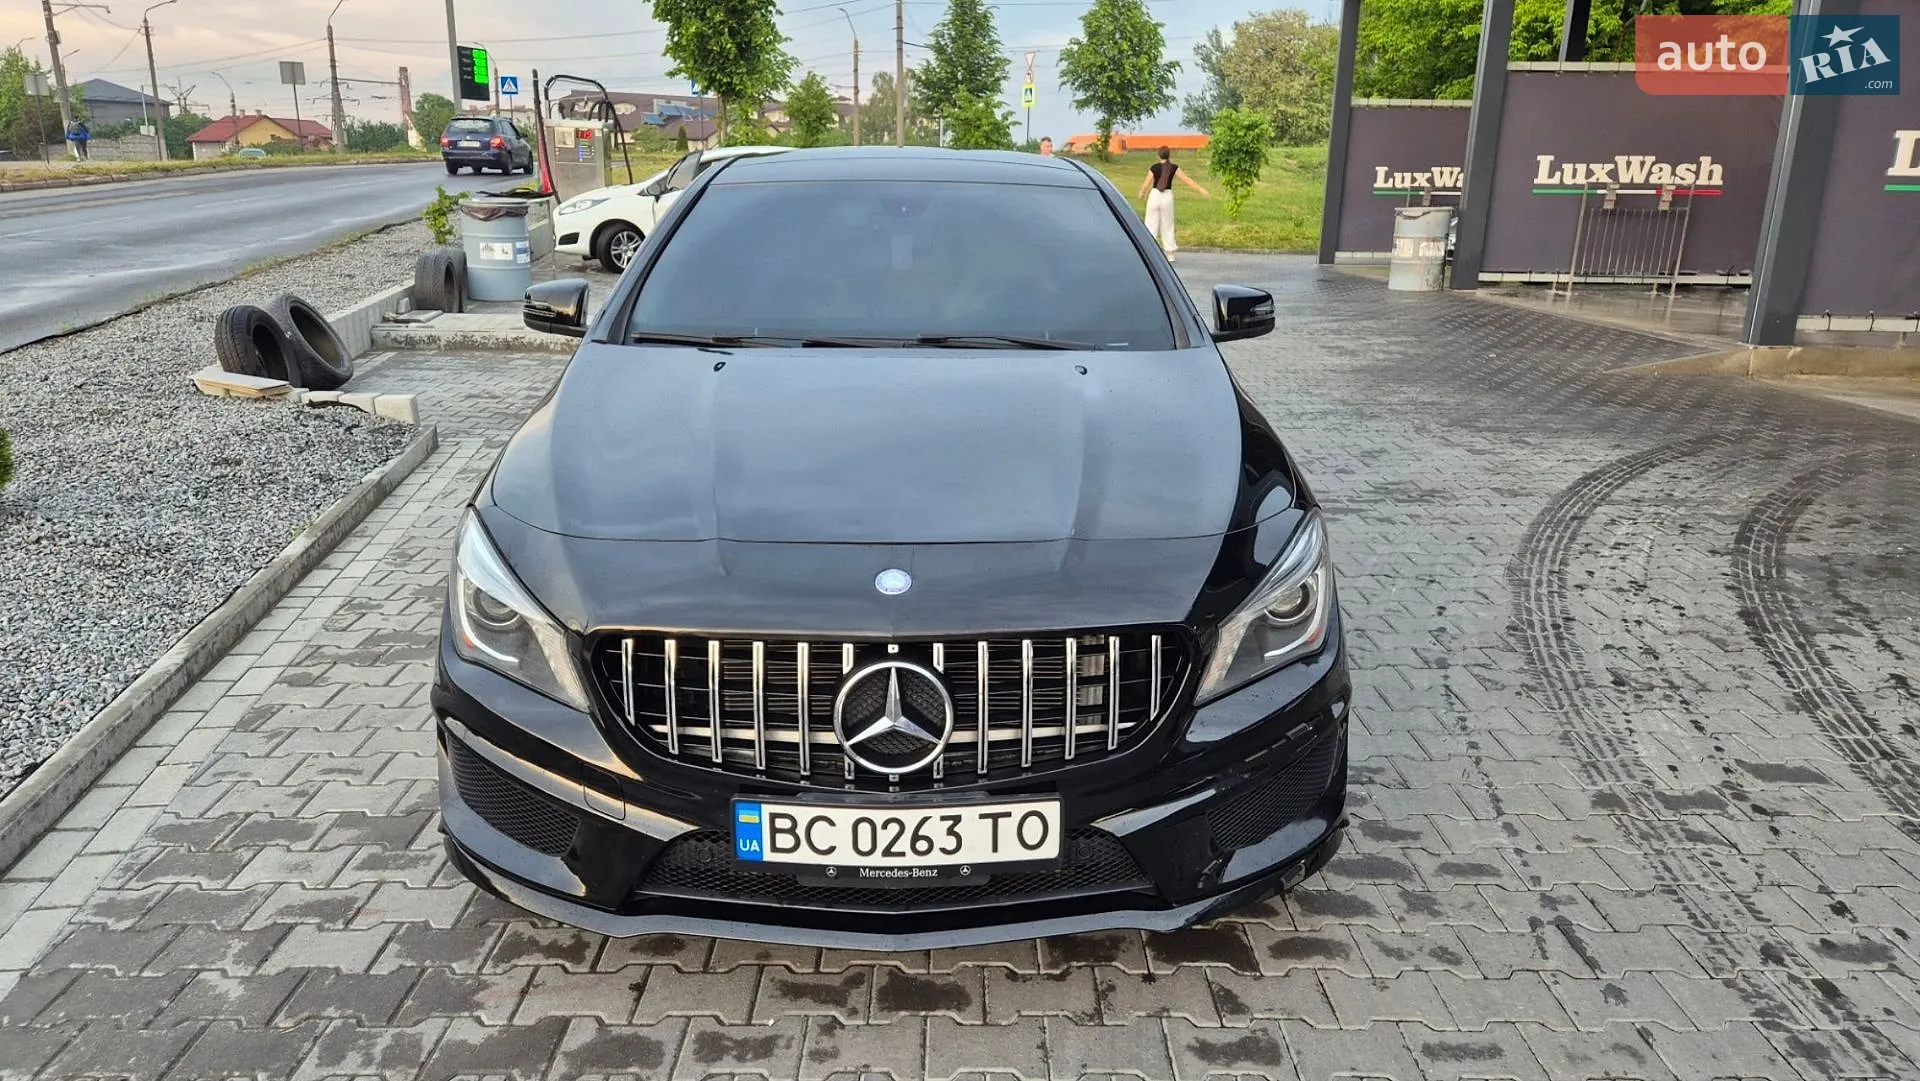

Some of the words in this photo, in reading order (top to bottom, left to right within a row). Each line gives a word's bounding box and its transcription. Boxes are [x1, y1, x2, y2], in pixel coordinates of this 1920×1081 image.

[1533, 154, 1724, 186] LuxWash
[739, 838, 760, 852] UA
[768, 811, 837, 856] BC
[851, 814, 963, 858] 0263
[978, 809, 1049, 853] TO
[859, 867, 939, 879] Mercedes-Benz
